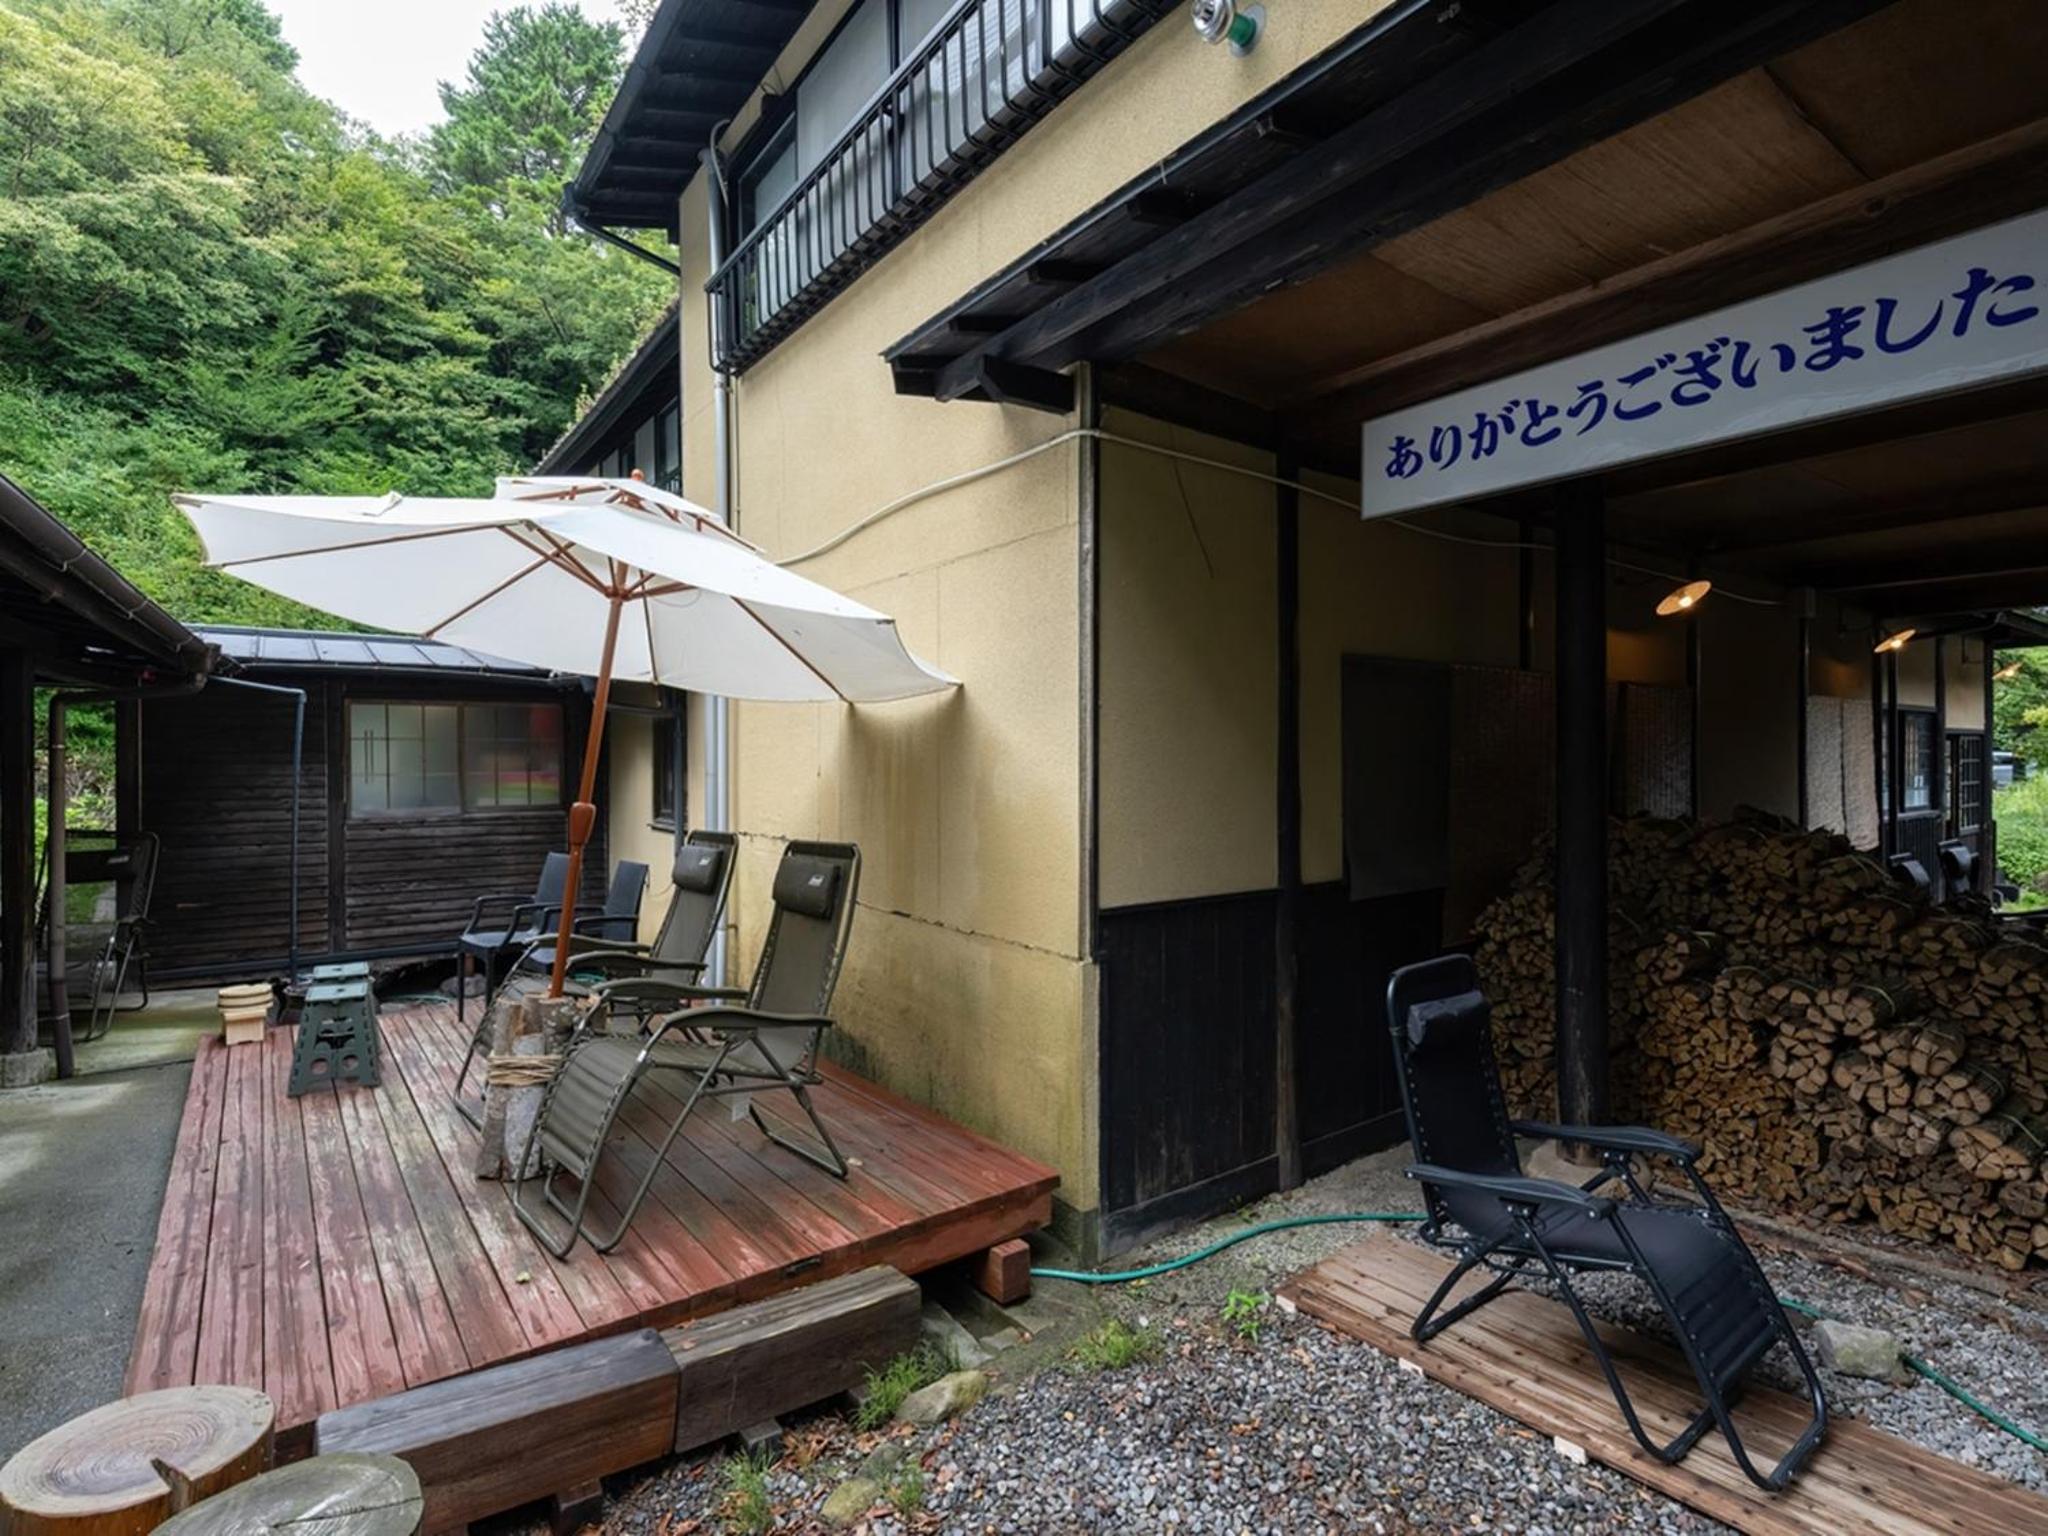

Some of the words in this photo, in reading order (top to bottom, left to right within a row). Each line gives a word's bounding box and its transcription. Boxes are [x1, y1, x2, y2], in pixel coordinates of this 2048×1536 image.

[1383, 267, 2041, 480] ありがとうございました
